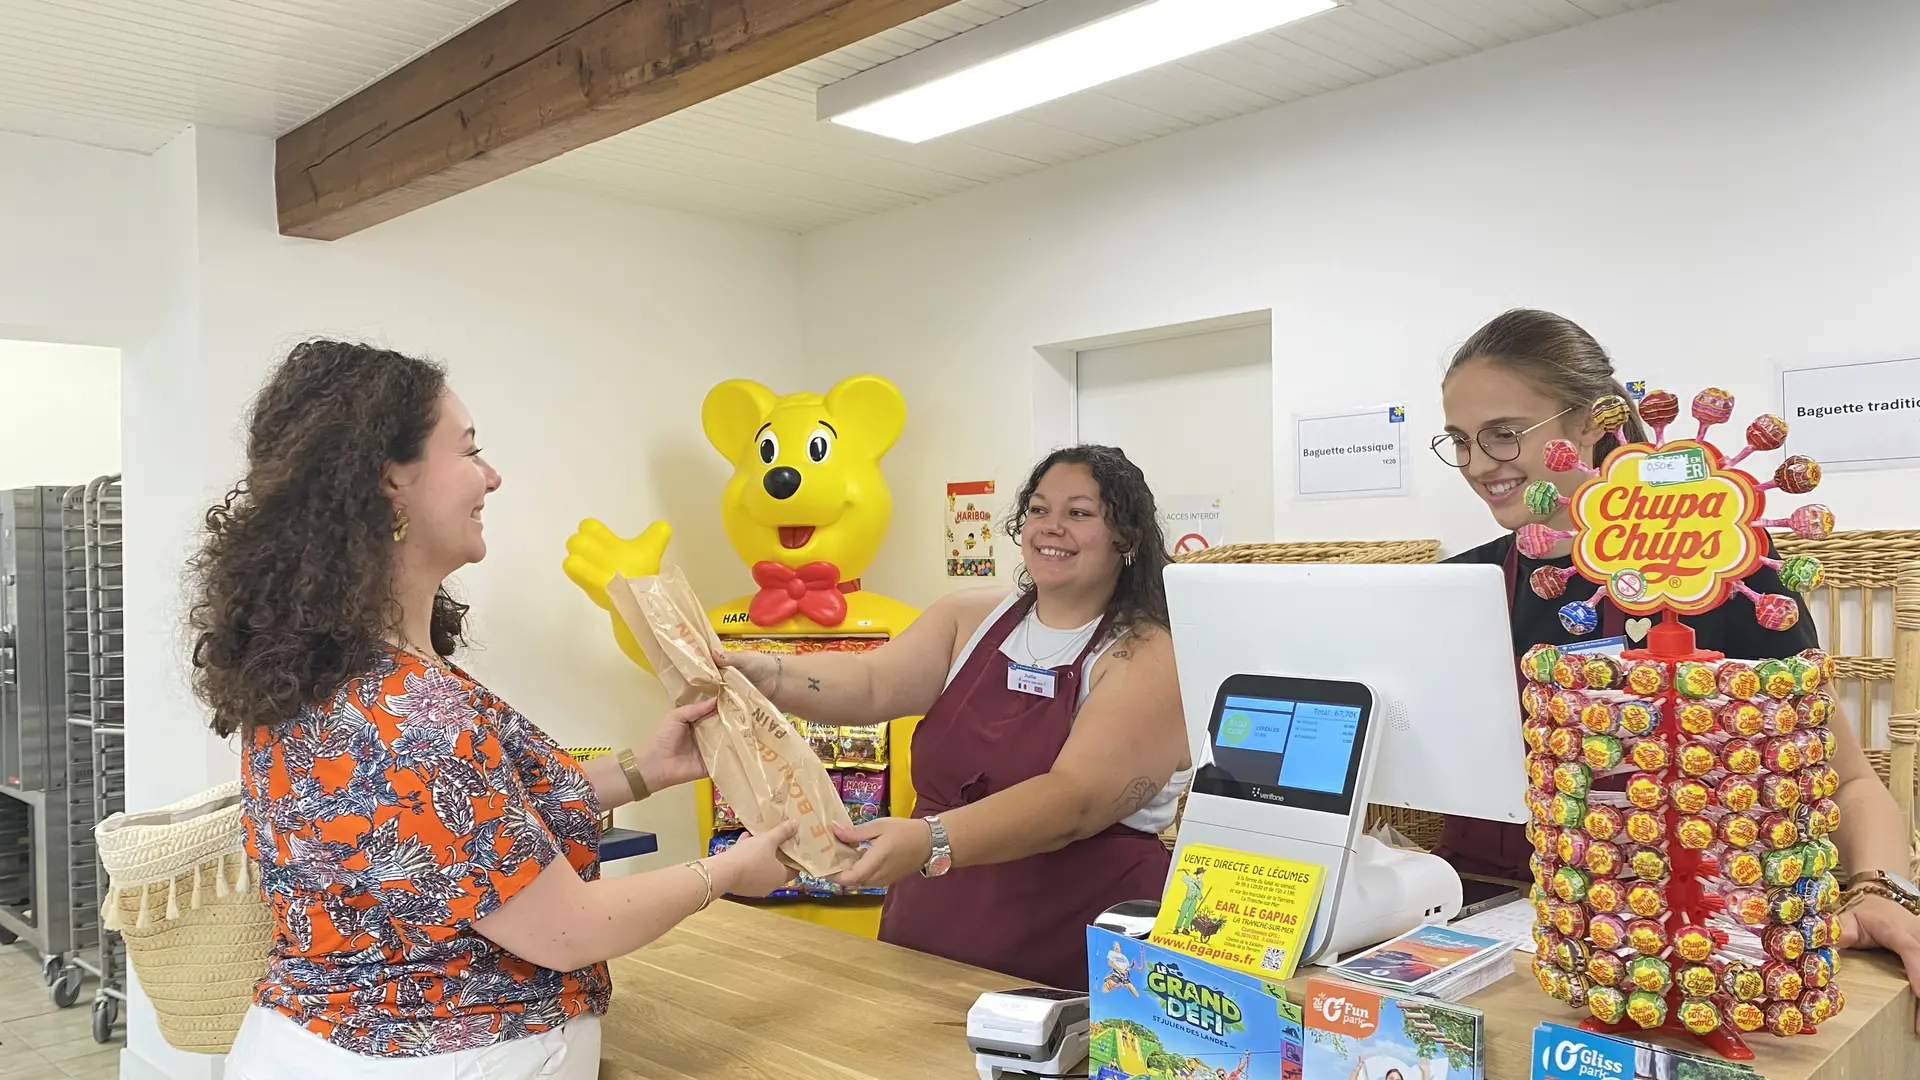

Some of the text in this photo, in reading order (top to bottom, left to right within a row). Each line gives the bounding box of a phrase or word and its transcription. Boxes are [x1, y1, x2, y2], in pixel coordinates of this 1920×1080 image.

[1797, 403, 1864, 418] Baguette
[1303, 442, 1394, 458] Baguette classique
[1646, 461, 1674, 472] 0,50€
[957, 511, 985, 520] HARIBO
[1190, 512, 1219, 520] INTERDIT
[1600, 486, 1727, 530] Chupa
[1594, 522, 1722, 584] Chups
[723, 613, 750, 624] HARI
[751, 707, 787, 741] PAIN
[1259, 792, 1285, 802] verifone
[777, 764, 834, 855] LE BON
[1184, 853, 1310, 883] VENTE DIRECTE DE LÉGUMES
[1215, 900, 1298, 926] EARL LE GAPIAS
[1242, 918, 1295, 934] TRANCHE-SUR-MER
[1152, 934, 1256, 966] www.legapias.fr
[1156, 965, 1167, 974] LE
[1148, 972, 1241, 1022] GRAND
[1167, 996, 1223, 1035] DÉFI
[1345, 1002, 1369, 1018] Fun
[1343, 1014, 1367, 1029] park
[1160, 1018, 1185, 1032] JULIEN
[1186, 1027, 1200, 1037] DES
[1200, 1031, 1229, 1048] LANDES
[1580, 1049, 1623, 1073] Gliss
[1578, 1064, 1608, 1079] park
